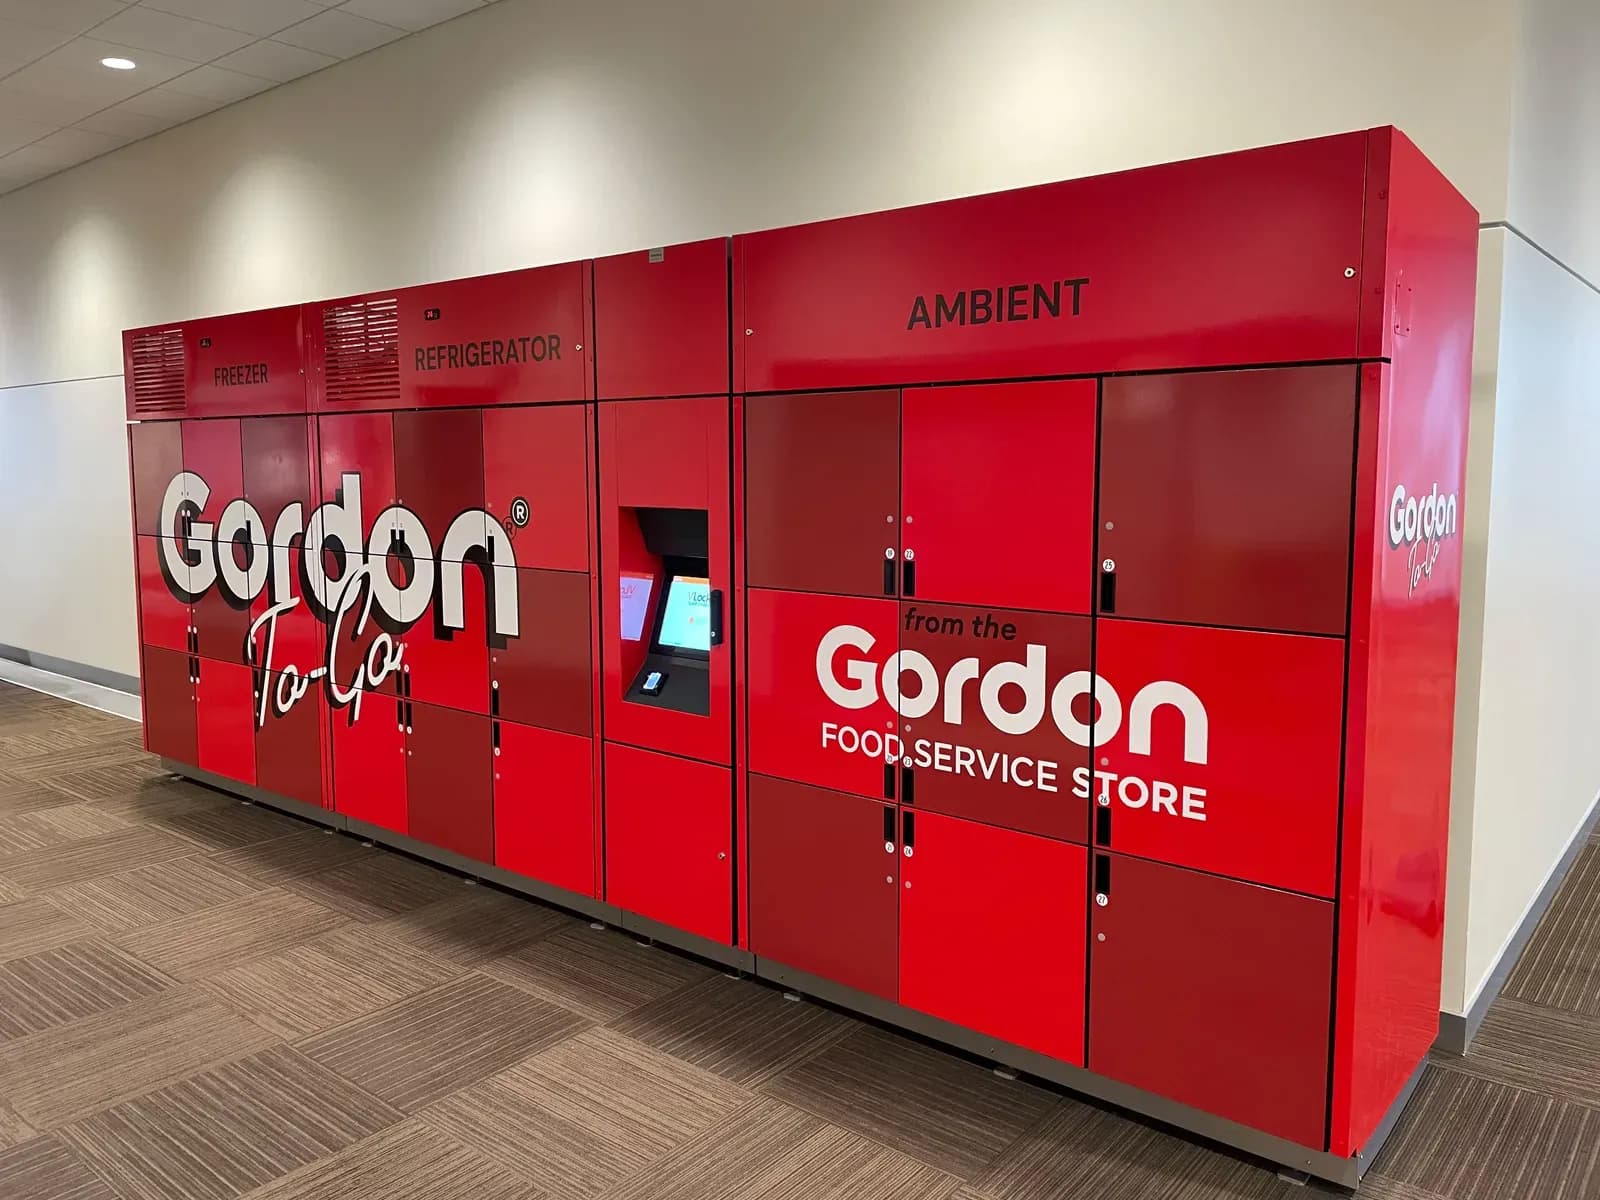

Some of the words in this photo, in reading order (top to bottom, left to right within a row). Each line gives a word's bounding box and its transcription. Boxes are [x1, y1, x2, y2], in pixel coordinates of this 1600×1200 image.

[907, 277, 1090, 331] AMBIENT
[213, 363, 269, 387] FREEZER
[414, 333, 562, 372] REFRIGERATOR
[1389, 482, 1457, 547] Gordon
[160, 470, 521, 640] Gordon
[904, 607, 965, 638] from
[971, 614, 1018, 642] the
[816, 624, 1209, 765] Gordon
[821, 722, 905, 763] FOOD
[914, 738, 1059, 794] SERVICE
[1071, 766, 1208, 822] STORE
